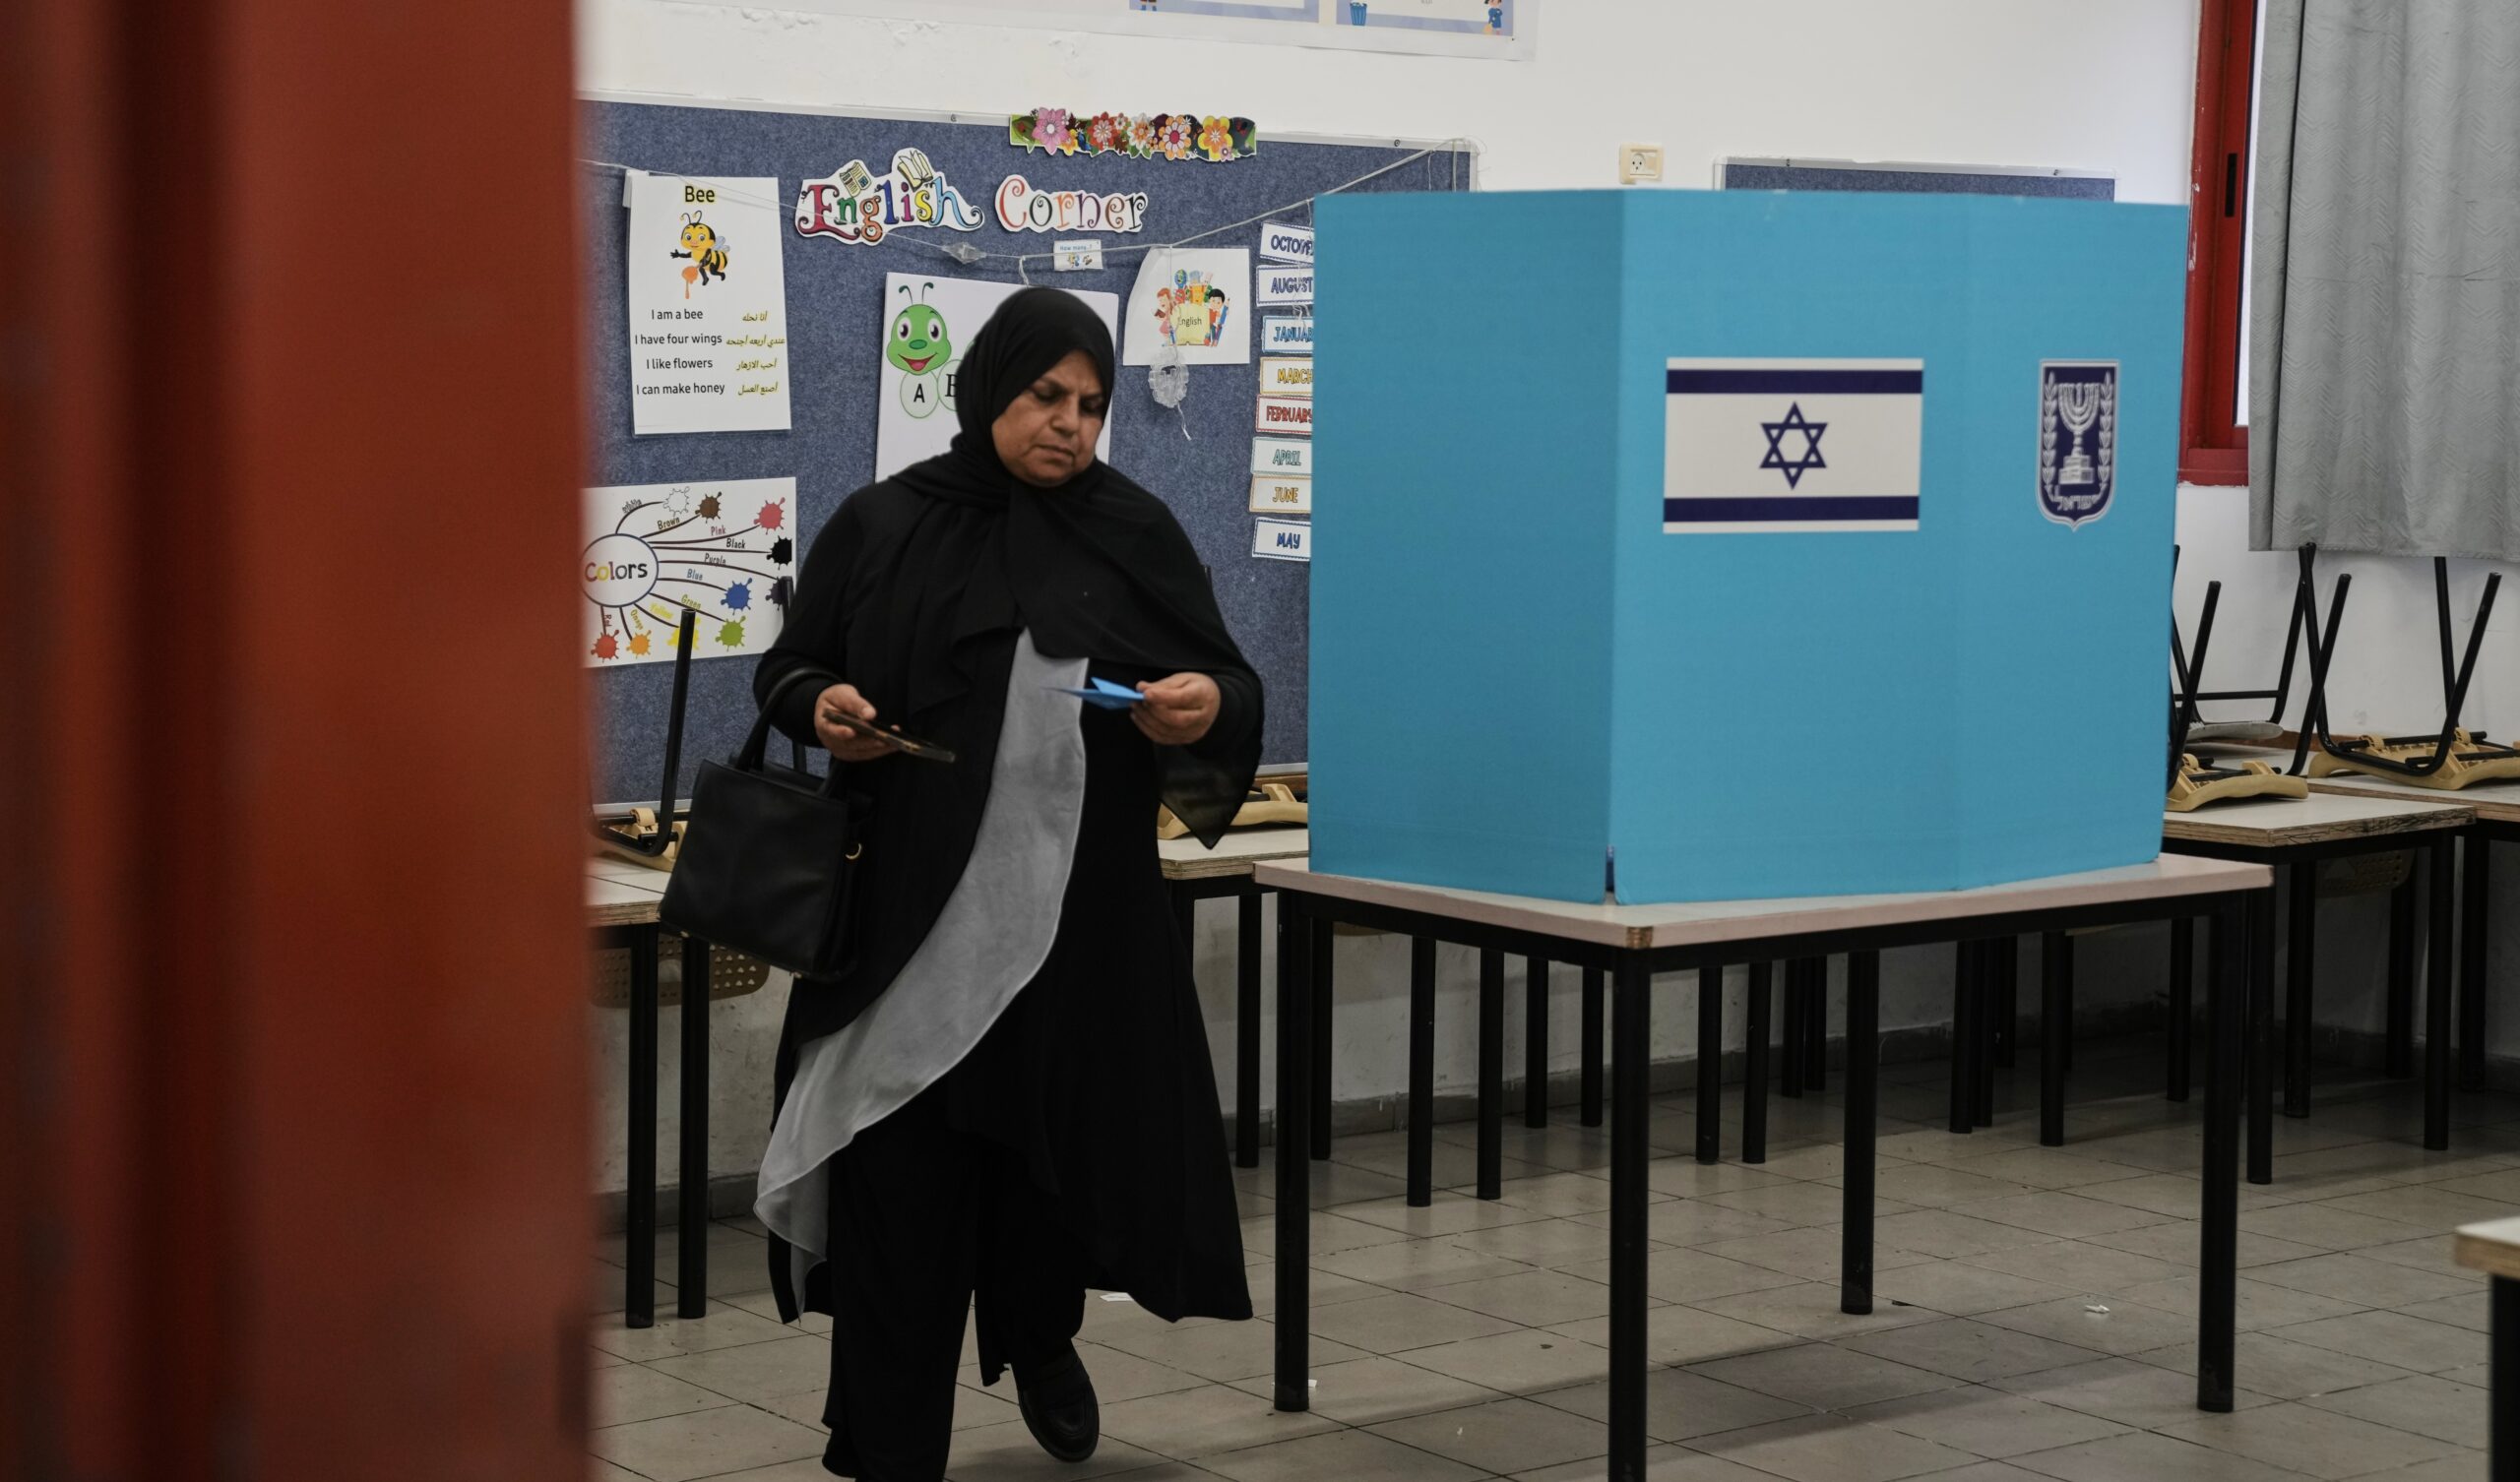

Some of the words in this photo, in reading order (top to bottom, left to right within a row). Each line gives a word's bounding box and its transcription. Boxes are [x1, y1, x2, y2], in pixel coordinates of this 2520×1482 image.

[684, 185, 716, 203] Bee
[797, 176, 984, 241] English
[998, 178, 1148, 229] Corner
[1270, 234, 1314, 256] OCTOBE
[1271, 277, 1314, 294] AUGUST
[651, 309, 655, 320] I
[657, 311, 673, 320] am
[675, 311, 681, 320] a
[683, 308, 704, 320] bee
[1177, 316, 1203, 328] English
[634, 334, 638, 345] I
[640, 333, 665, 344] have
[666, 333, 689, 344] four
[691, 333, 723, 345] wings
[646, 358, 650, 370] I
[652, 357, 671, 370] like
[672, 356, 714, 369] flowers
[1277, 368, 1313, 385] MARCH
[636, 384, 640, 396] I
[641, 385, 661, 395] can
[662, 382, 691, 395] make
[693, 382, 725, 396] honey
[913, 383, 925, 403] A
[1272, 449, 1301, 466] APRIL
[1272, 486, 1299, 504] JUNE
[2053, 484, 2100, 512] ישראל
[657, 517, 681, 530] Brown
[710, 525, 726, 536] Pink
[725, 537, 746, 549] Black
[1276, 532, 1301, 549] MAY
[704, 552, 726, 567] Purple
[585, 561, 649, 582] Colors
[686, 568, 704, 582] Blue
[680, 593, 702, 610] Green
